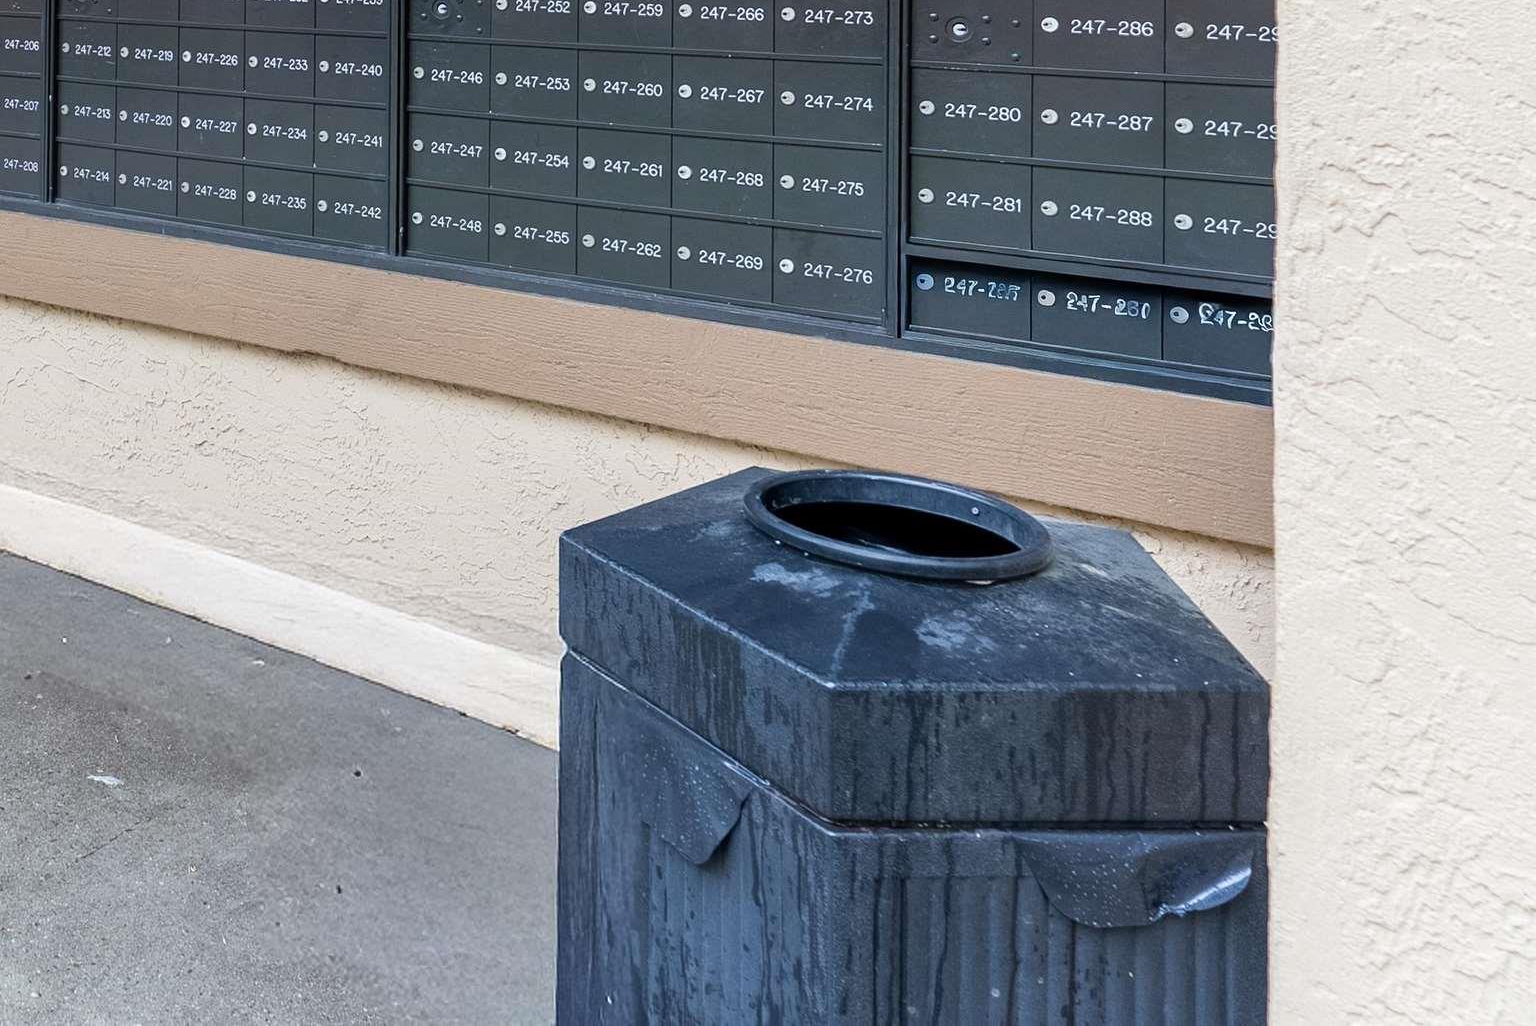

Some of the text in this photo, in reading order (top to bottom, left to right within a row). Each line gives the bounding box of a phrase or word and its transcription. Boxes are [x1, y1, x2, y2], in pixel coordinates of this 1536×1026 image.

[516, 0, 570, 13] 247-252
[604, 3, 663, 16] 247-259
[701, 6, 764, 21] 247-266
[805, 10, 873, 25] 247-273
[1071, 20, 1153, 36] 247-286
[5, 39, 39, 51] 247-206
[76, 45, 111, 56] 247-212
[135, 49, 173, 61] 247-219
[197, 53, 238, 66] 247-226
[264, 57, 308, 70] 247-233
[336, 62, 382, 76] 247-240
[432, 69, 482, 84] 247-246
[515, 75, 570, 90] 247-253
[604, 81, 662, 96] 247-260
[701, 87, 764, 102] 247-267
[5, 99, 38, 110] 247-207
[805, 94, 873, 111] 247-274
[75, 106, 110, 119] 247-213
[133, 113, 172, 126] 247-220
[945, 103, 1021, 121] 247-280
[196, 119, 237, 132] 247-227
[1071, 112, 1153, 131] 247-287
[263, 125, 306, 139] 247-234
[336, 132, 382, 147] 247-241
[431, 142, 482, 157] 247-247
[4, 158, 38, 172] 247-208
[515, 151, 569, 168] 247-254
[74, 168, 109, 181] 247-214
[604, 159, 662, 177] 247-261
[134, 176, 172, 190] 247-221
[700, 168, 763, 186] 247-268
[195, 185, 236, 200] 247-228
[803, 178, 864, 196] 247-275
[263, 193, 306, 209] 247-235
[947, 192, 1021, 212] 247-281
[335, 203, 381, 219] 247-242
[1071, 205, 1152, 226] 247-288
[431, 215, 481, 232] 247-248
[514, 226, 569, 244] 247-255
[603, 238, 661, 257] 247-262
[700, 250, 762, 270] 247-269
[804, 263, 872, 284] 247-276
